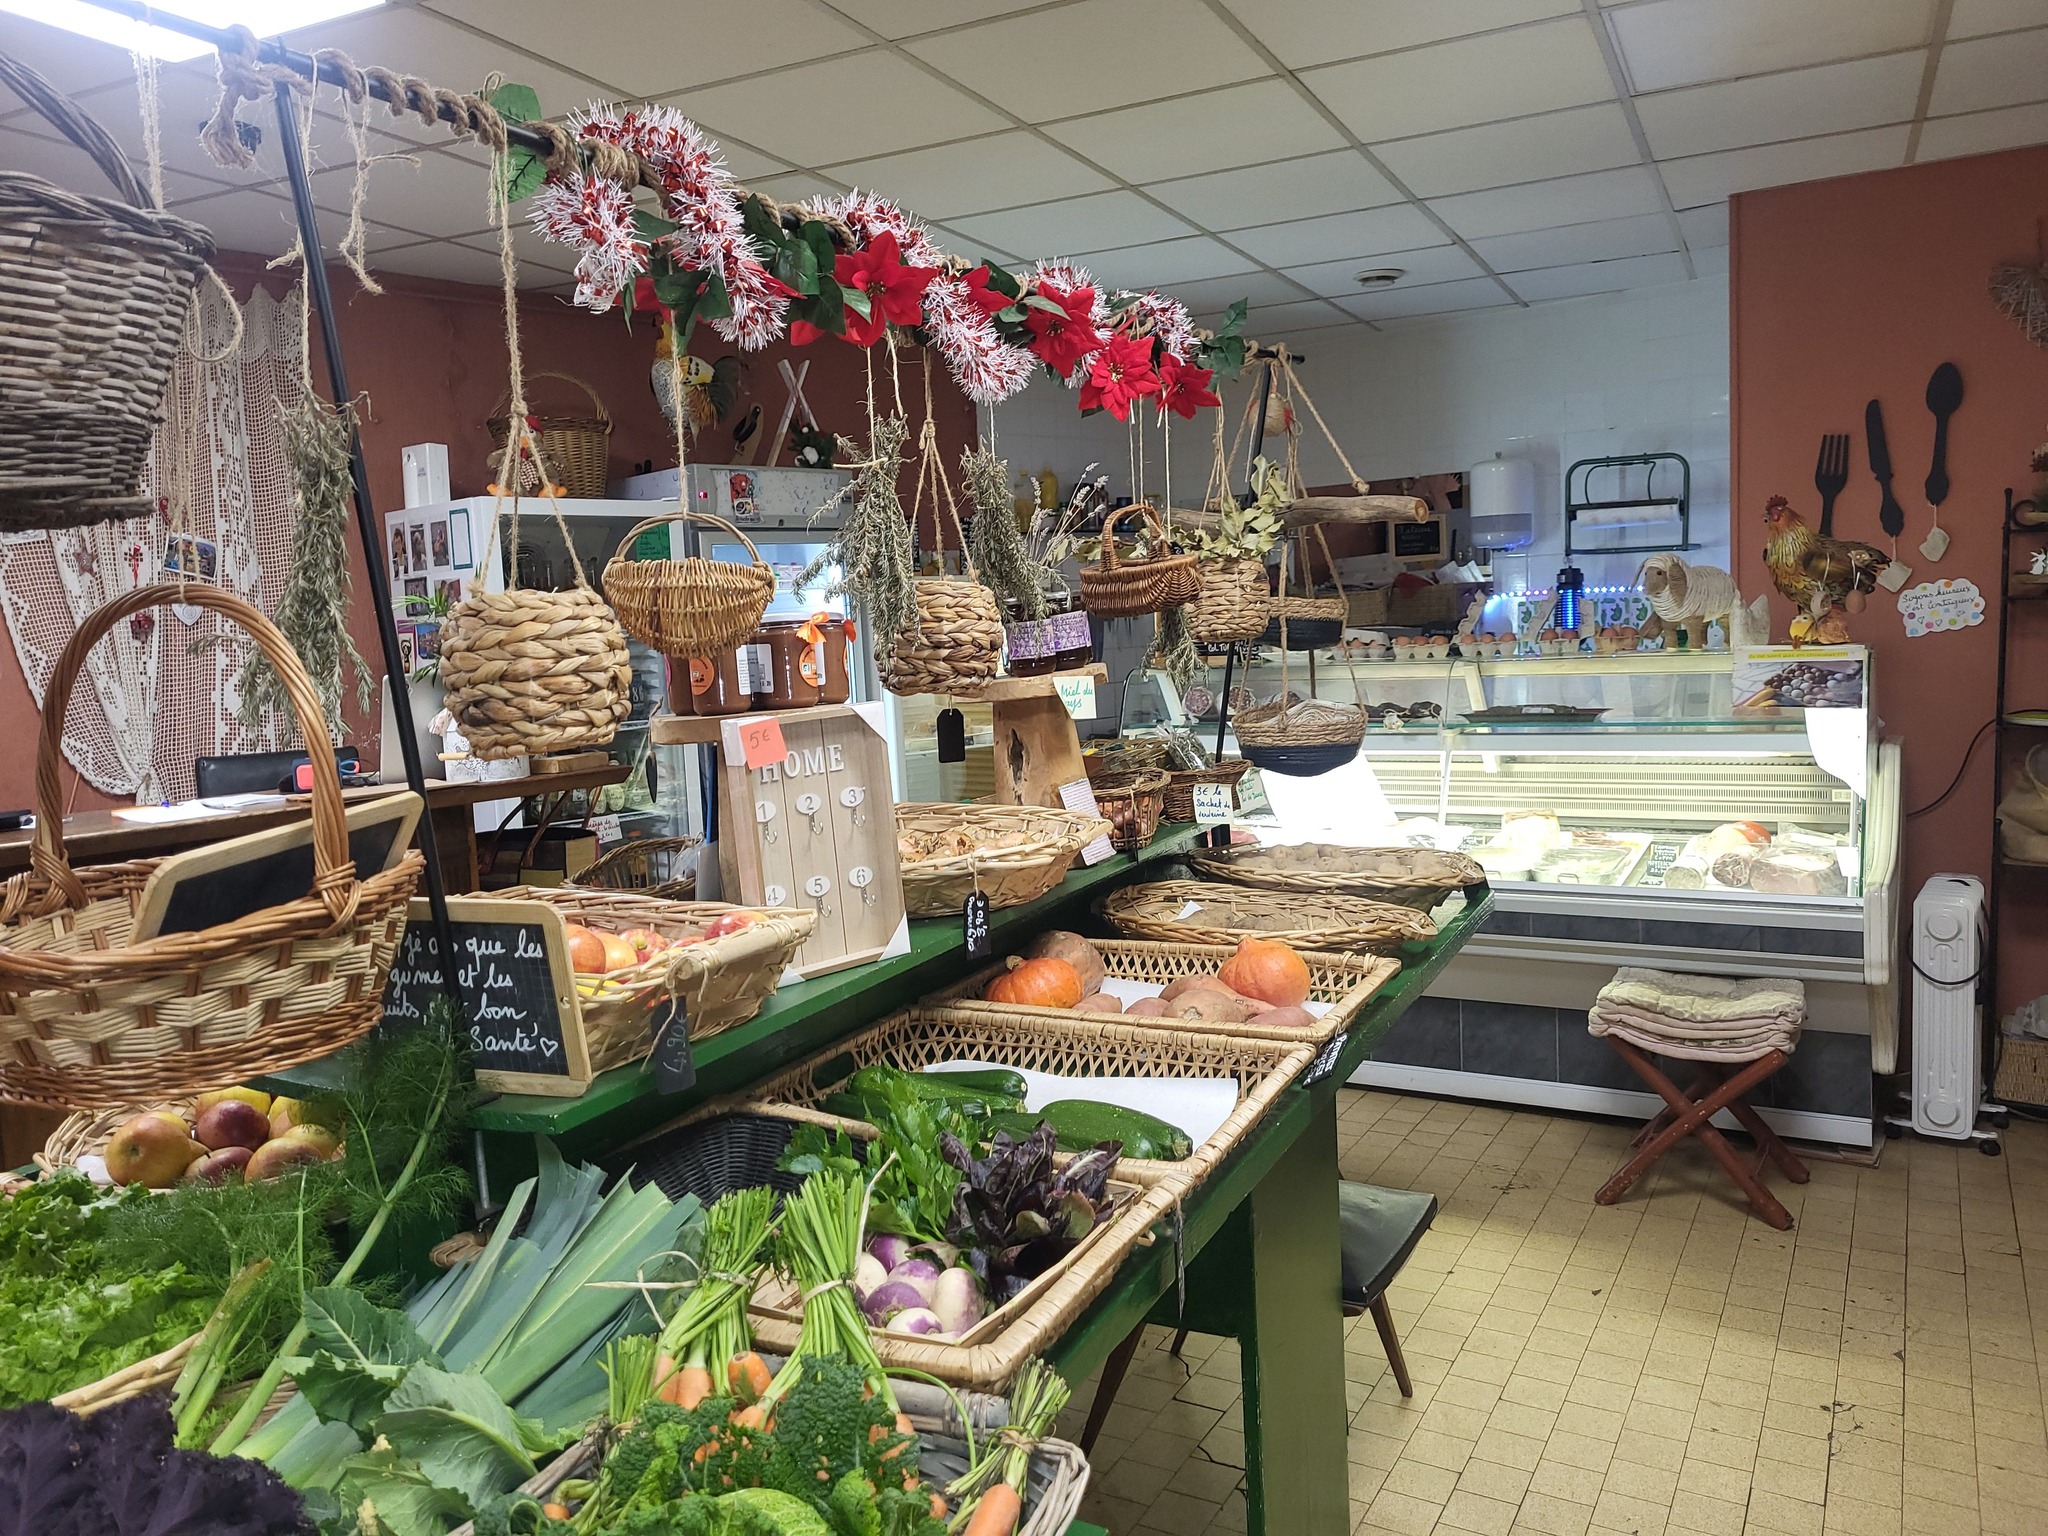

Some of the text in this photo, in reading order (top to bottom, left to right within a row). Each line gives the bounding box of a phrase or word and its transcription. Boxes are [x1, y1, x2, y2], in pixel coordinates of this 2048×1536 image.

[1902, 593, 1934, 605] Soyons
[1061, 680, 1093, 697] Miel du
[1065, 698, 1082, 713] ays
[760, 743, 845, 784] HOME
[1196, 786, 1208, 796] 3€
[1196, 797, 1222, 808] Sachet
[757, 789, 857, 820] 1 2 3
[767, 868, 867, 903] 4 5 6
[466, 936, 506, 973] que
[514, 928, 544, 958] les
[458, 963, 480, 988] et
[483, 962, 514, 988] les
[473, 992, 528, 1021] bon
